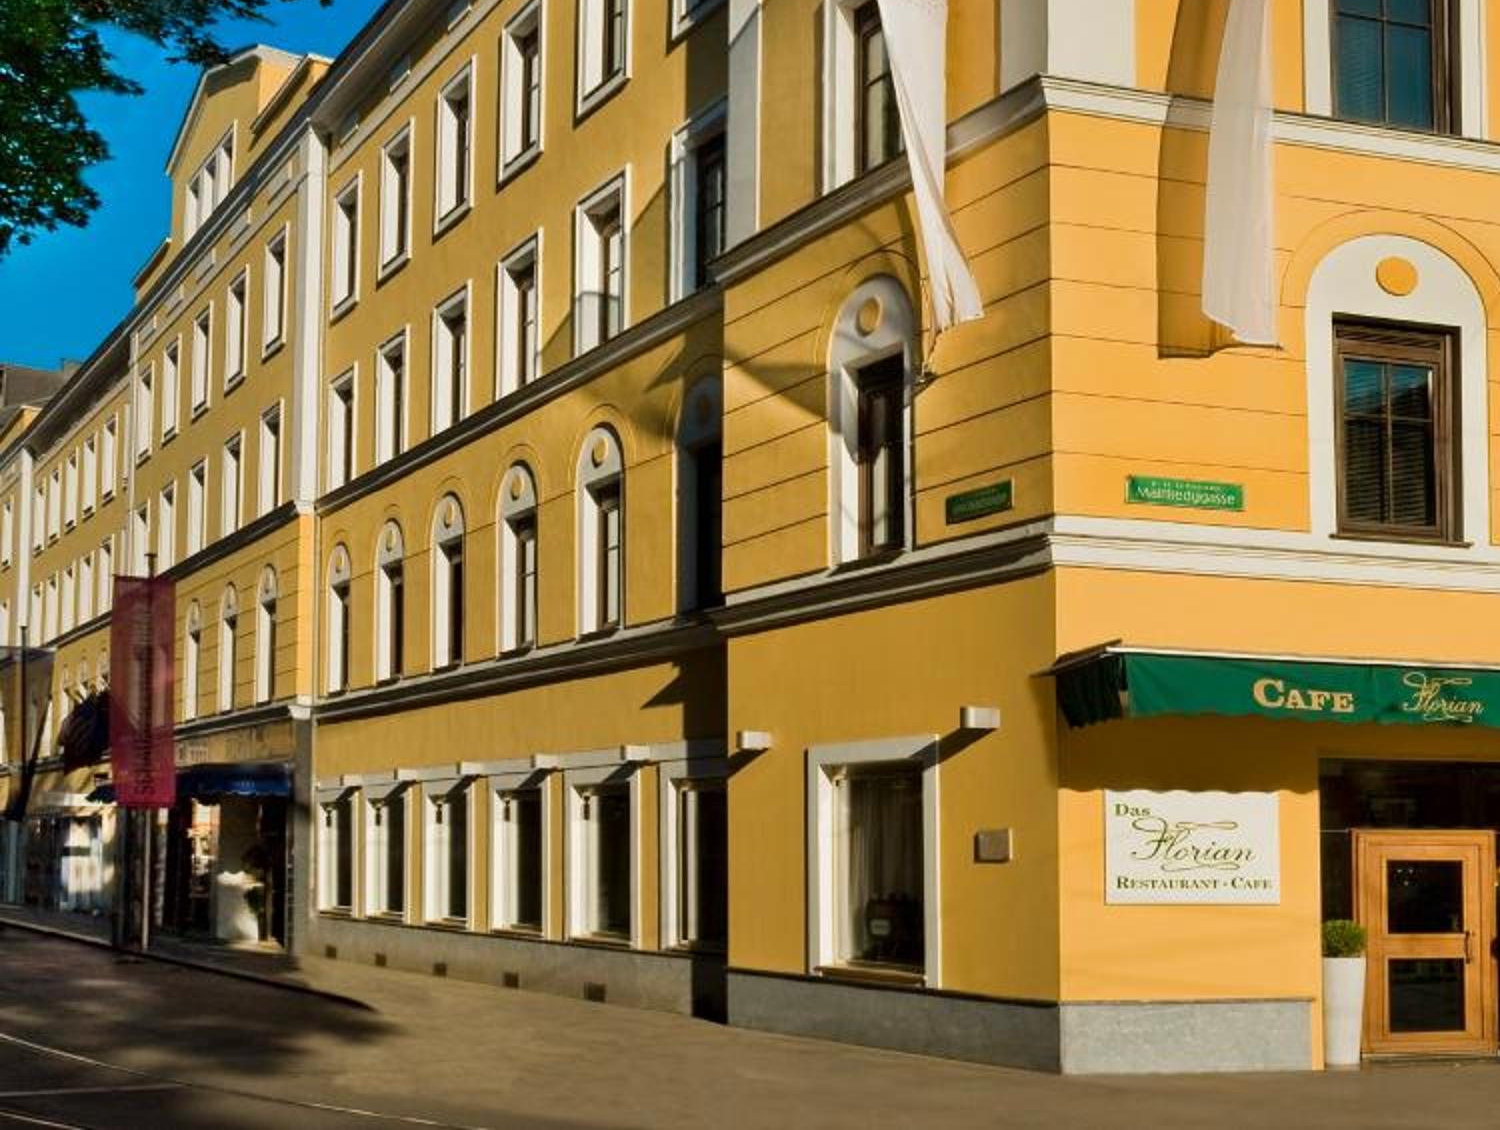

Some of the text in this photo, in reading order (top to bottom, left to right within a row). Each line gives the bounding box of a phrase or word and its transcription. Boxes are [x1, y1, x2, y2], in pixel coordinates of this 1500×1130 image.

[1253, 678, 1355, 713] CAFE
[1403, 671, 1484, 722] Florian
[1115, 803, 1151, 816] Das
[1131, 817, 1256, 871] Florian
[1116, 875, 1272, 889] RESTAURANT CAFE
